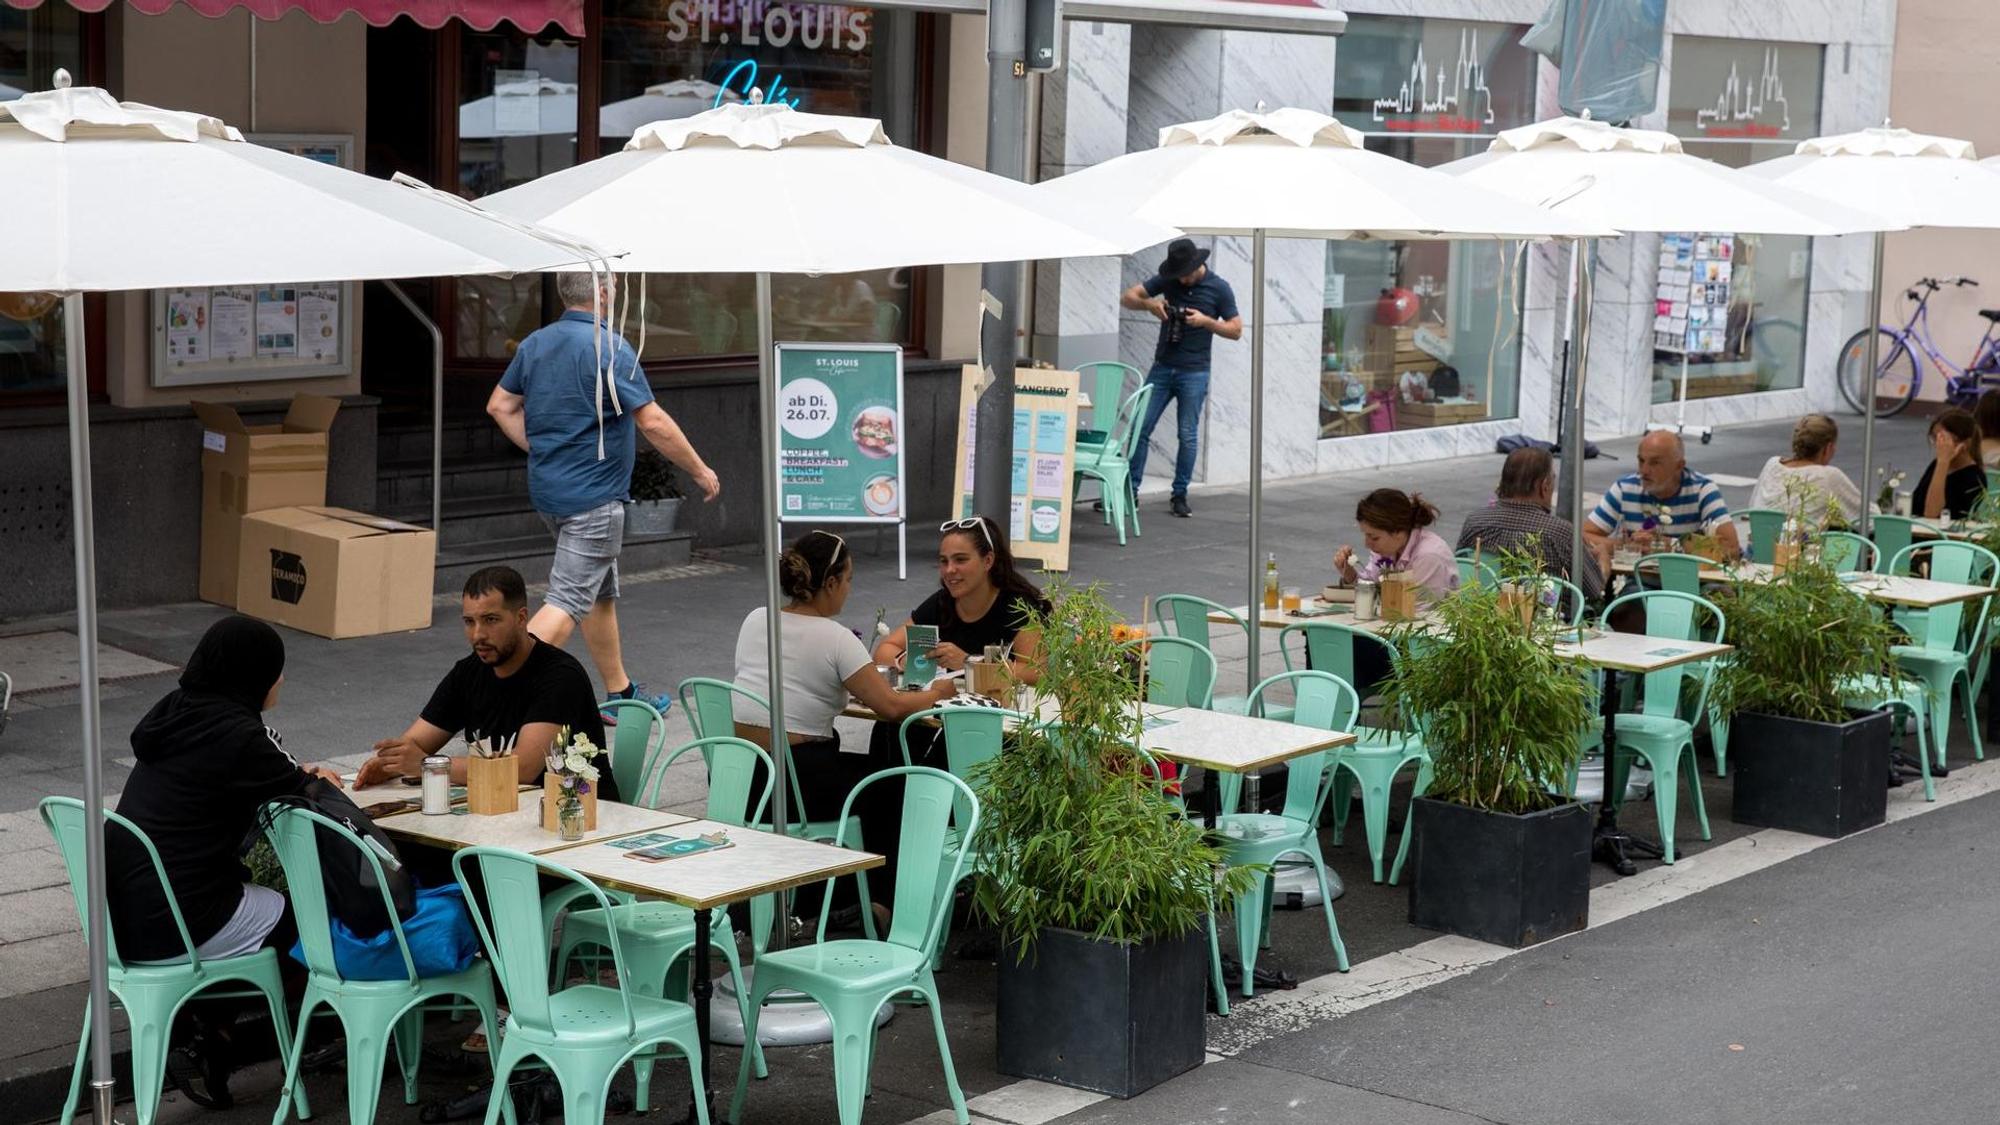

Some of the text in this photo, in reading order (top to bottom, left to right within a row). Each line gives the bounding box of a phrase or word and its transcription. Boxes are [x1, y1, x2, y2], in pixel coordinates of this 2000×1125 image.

[789, 395, 828, 407] ab Di.
[787, 409, 830, 421] 26.07.
